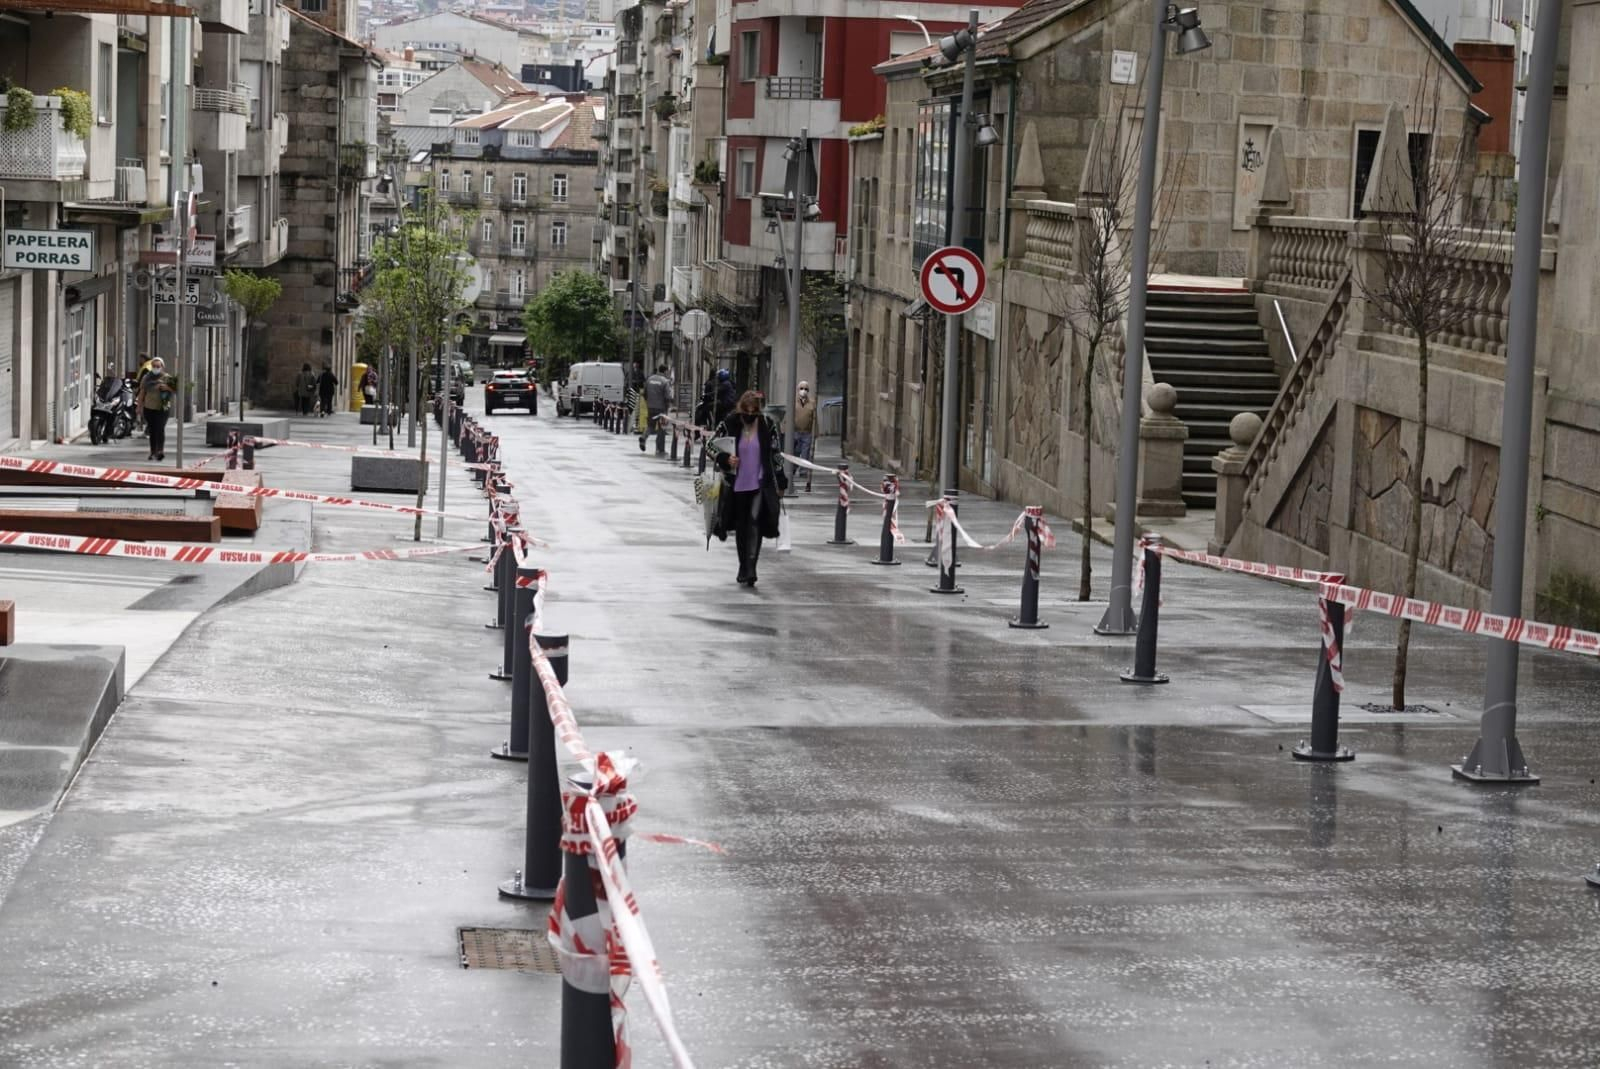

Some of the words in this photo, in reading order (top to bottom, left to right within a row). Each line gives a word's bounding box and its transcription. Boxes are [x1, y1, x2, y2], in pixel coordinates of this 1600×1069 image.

[7, 234, 89, 248] PAPELERA
[15, 252, 80, 265] PORRAS
[62, 465, 73, 474] NO
[73, 466, 95, 475] PASAR
[28, 535, 57, 547] PASAR
[58, 537, 70, 548] NO
[124, 543, 151, 556] PASAR
[154, 546, 167, 557] NO
[220, 551, 248, 562] PASAR
[250, 552, 262, 563] NO
